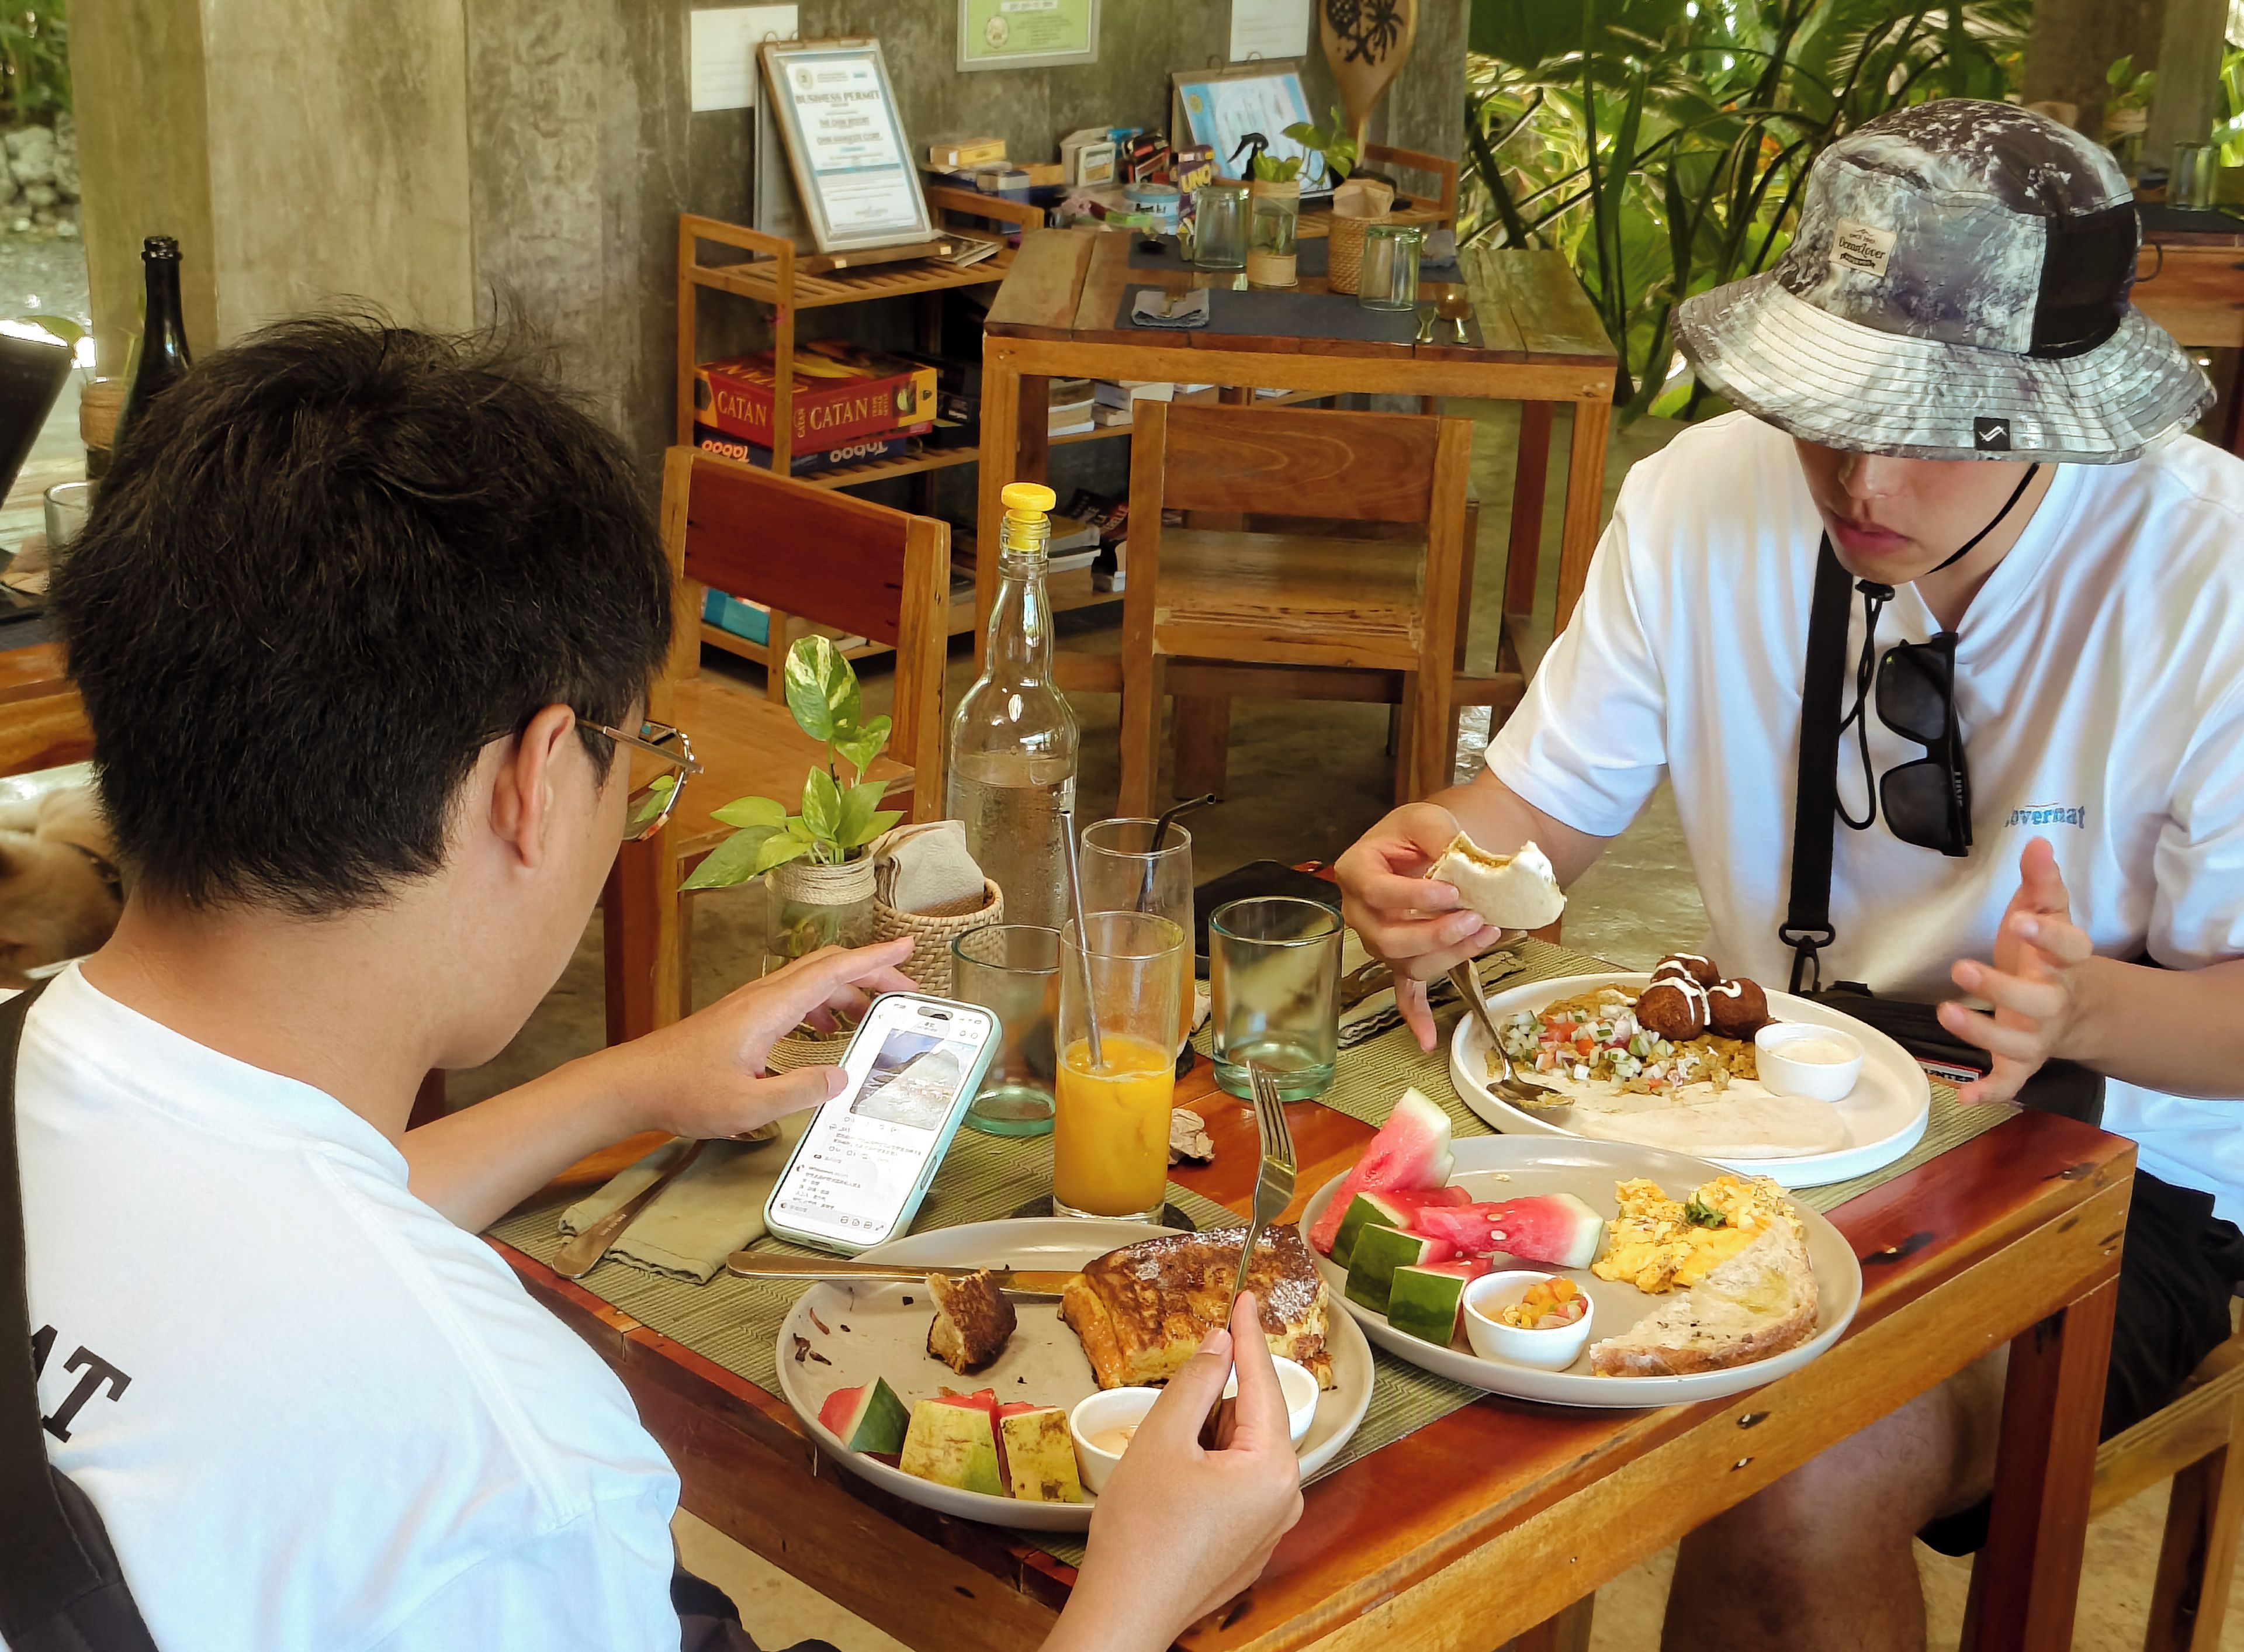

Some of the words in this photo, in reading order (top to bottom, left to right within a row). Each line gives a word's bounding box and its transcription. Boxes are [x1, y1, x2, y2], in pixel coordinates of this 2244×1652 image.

[795, 92, 842, 104] BUSINESS
[843, 91, 879, 102] PERMIT
[1180, 163, 1211, 193] UNO
[718, 391, 767, 427] CATAN
[810, 397, 868, 430] CATAN
[702, 440, 750, 463] Taboo
[830, 442, 888, 463] Taboo
